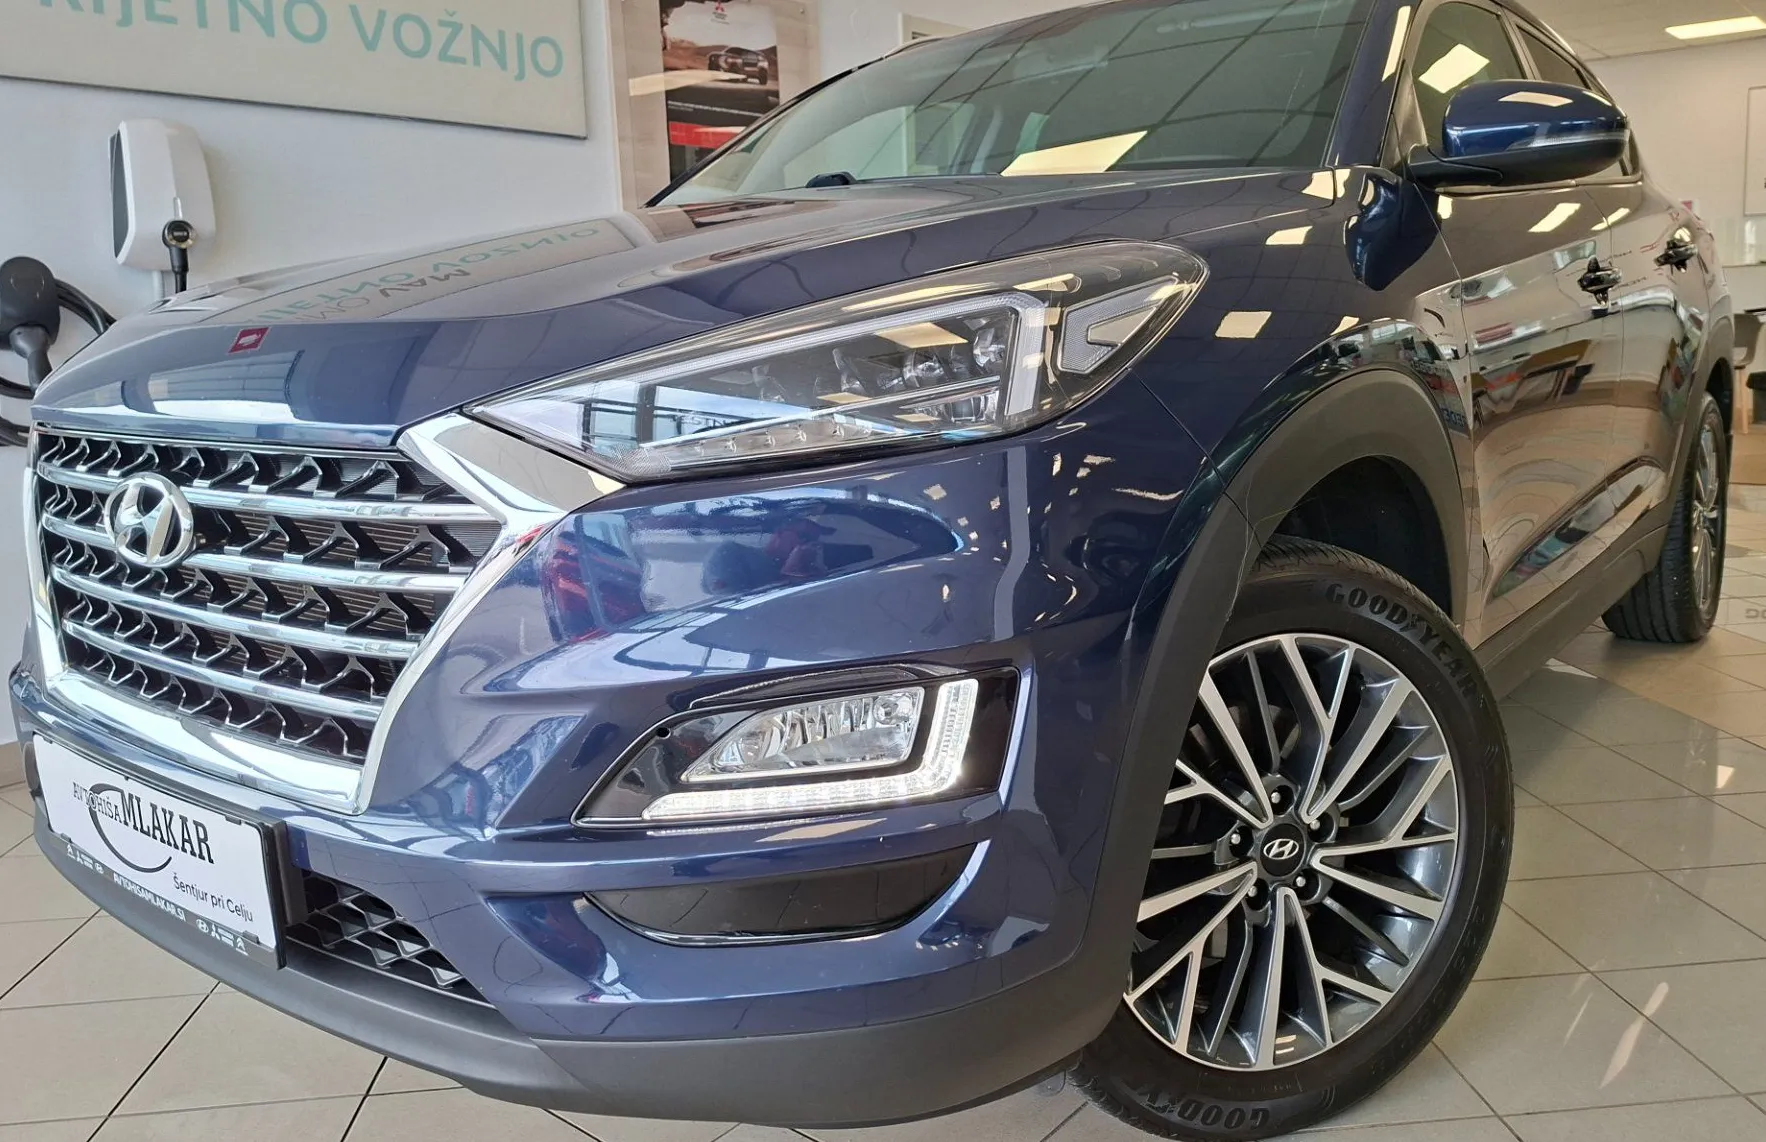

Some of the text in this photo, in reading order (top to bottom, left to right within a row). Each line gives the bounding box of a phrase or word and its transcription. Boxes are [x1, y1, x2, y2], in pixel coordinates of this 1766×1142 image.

[349, 4, 564, 81] VOŽNJO
[1325, 583, 1479, 698] GOODYEAR
[120, 790, 215, 865] MLAKAR
[173, 872, 254, 923] Šentjur pri Celju
